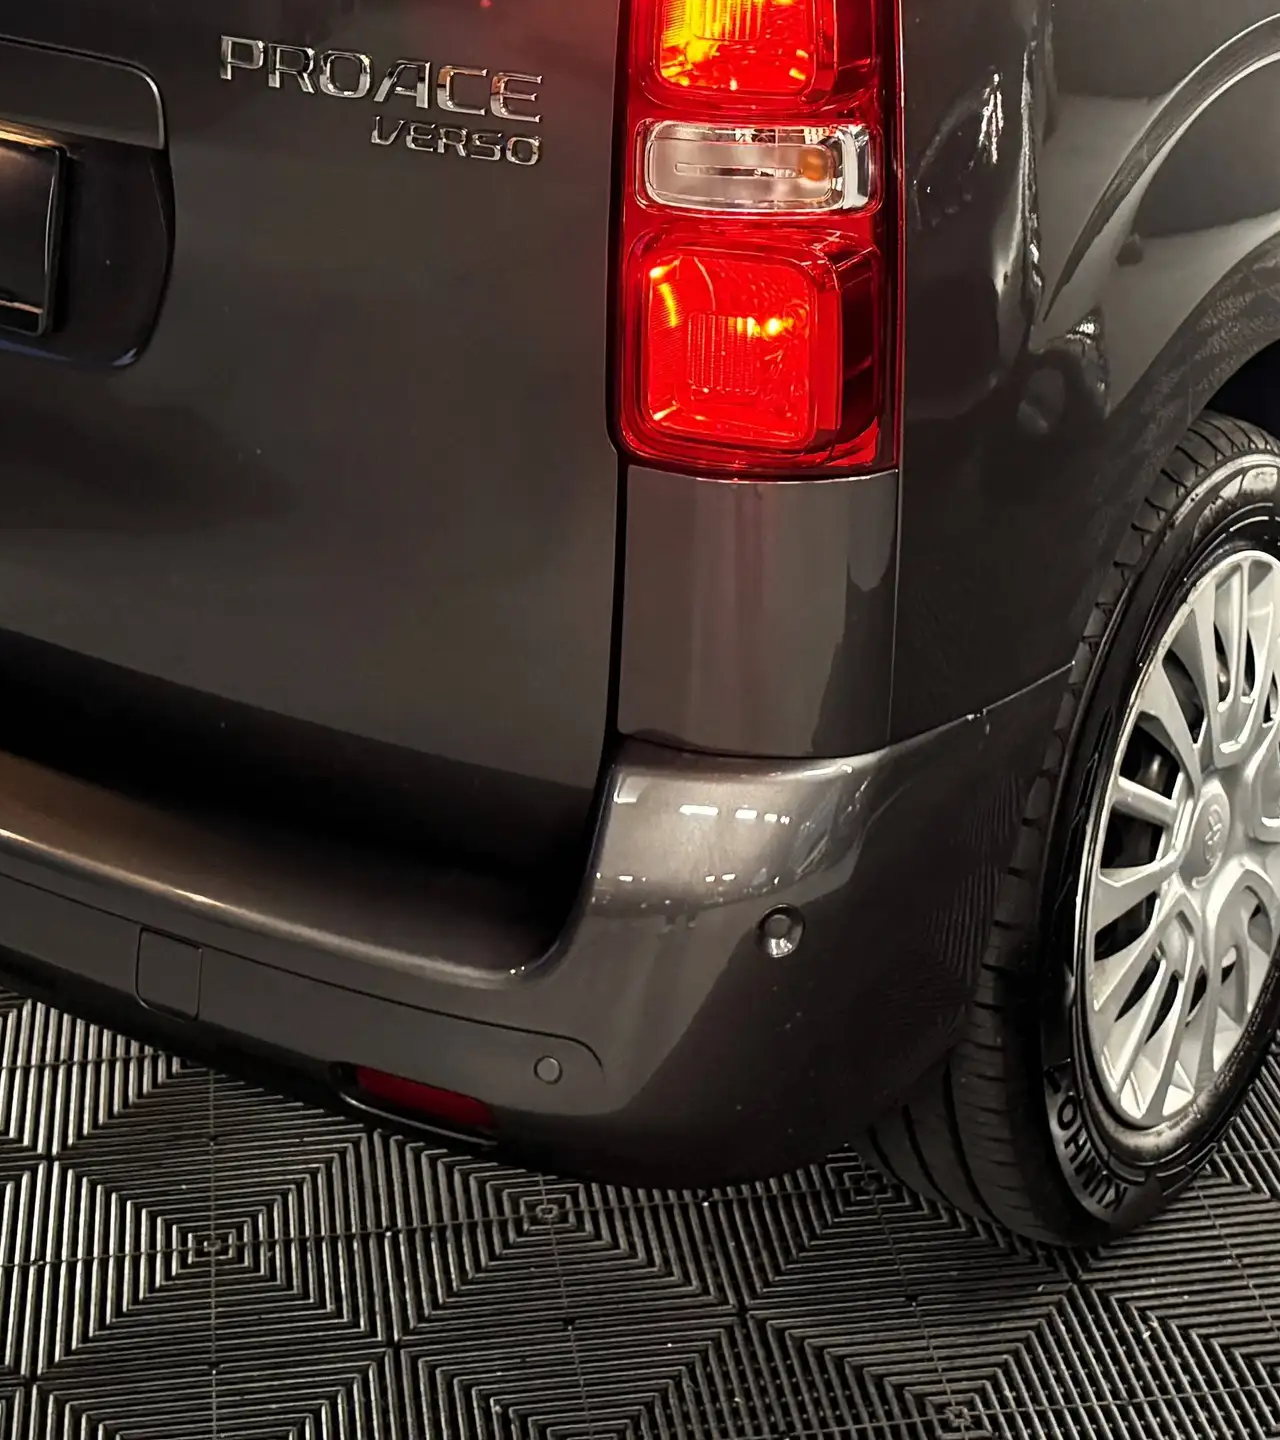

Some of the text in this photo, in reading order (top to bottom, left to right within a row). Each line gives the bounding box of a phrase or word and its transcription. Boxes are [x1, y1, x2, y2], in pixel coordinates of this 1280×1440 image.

[221, 34, 544, 123] PROACE
[371, 116, 543, 166] VERSO
[1057, 1094, 1129, 1213] KUMHO
